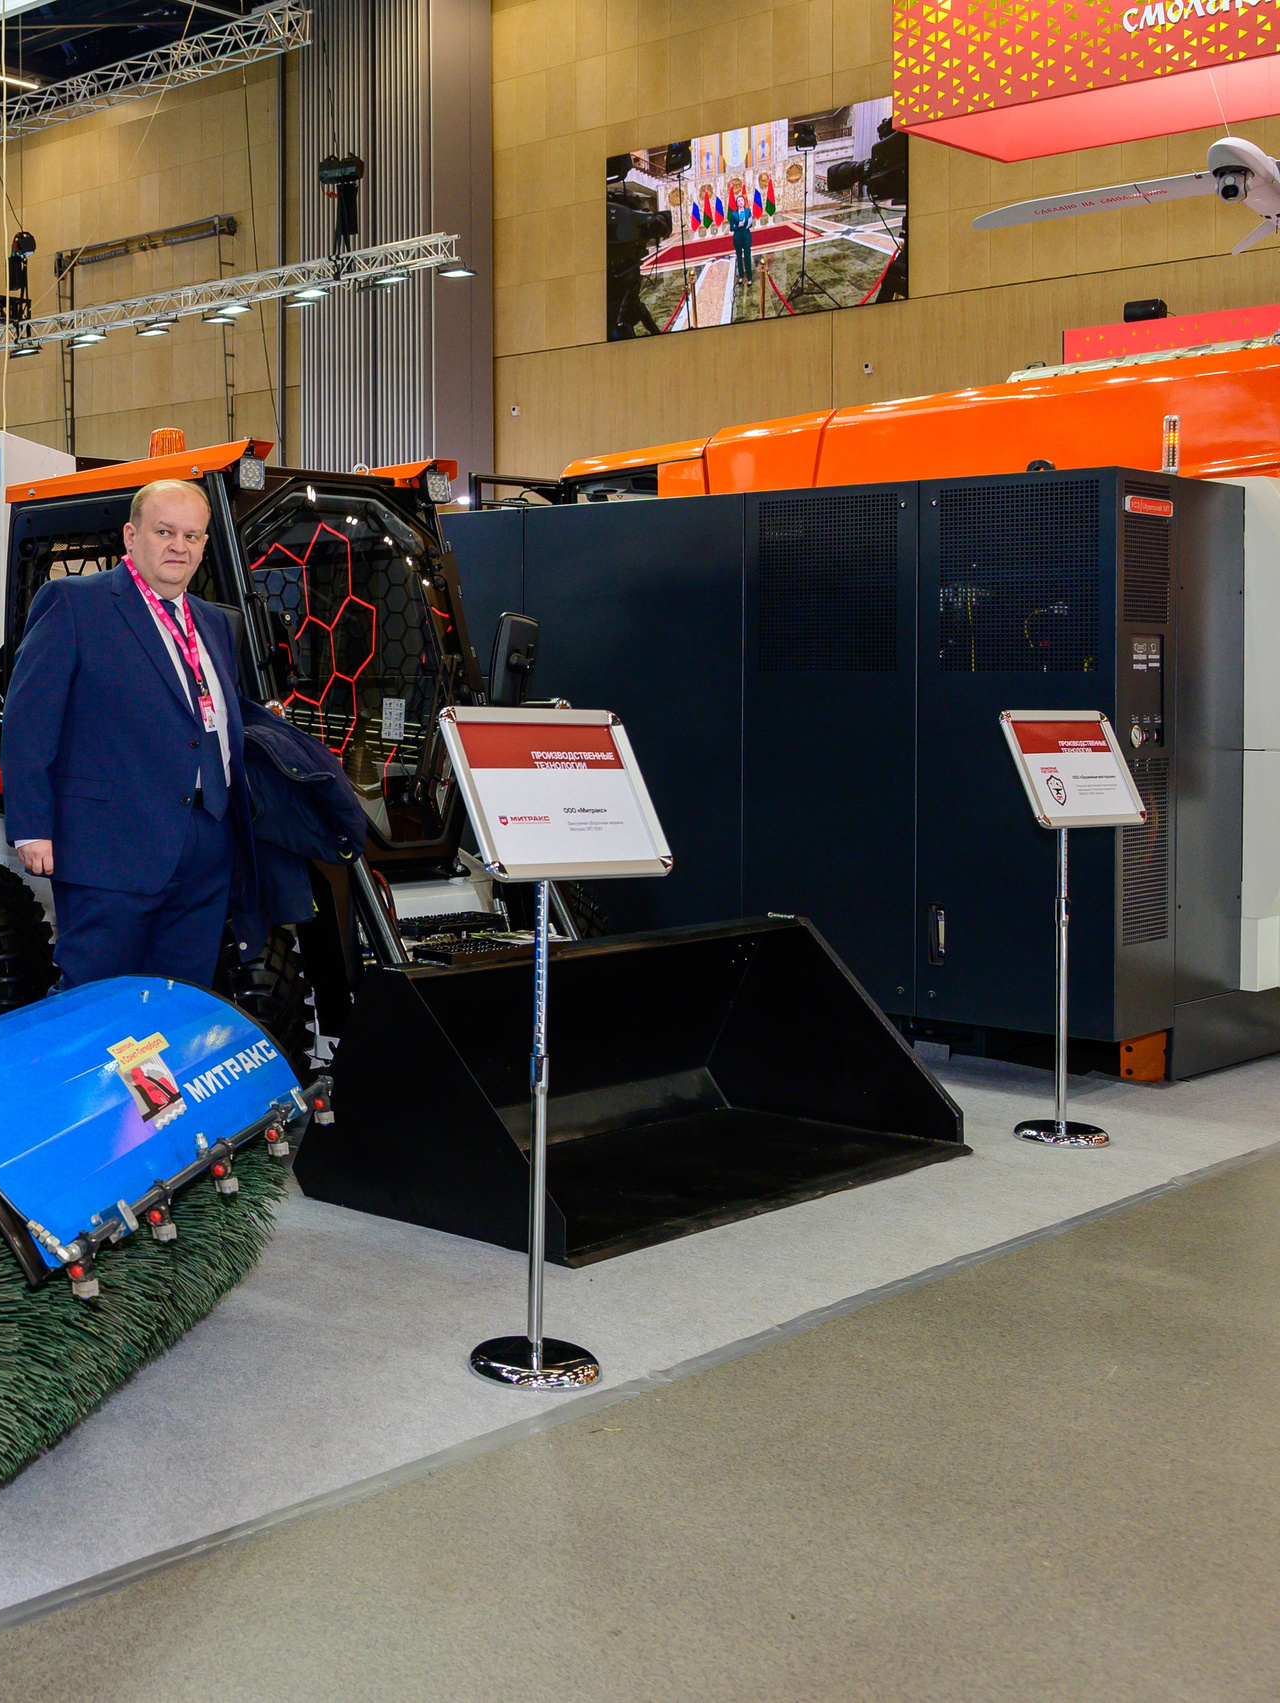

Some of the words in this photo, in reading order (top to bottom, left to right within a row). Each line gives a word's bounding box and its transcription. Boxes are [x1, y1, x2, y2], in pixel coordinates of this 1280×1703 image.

[531, 751, 616, 761] ПРОИЗВОДСТВЕННЫЕ
[534, 761, 588, 769] ТЕХНОЛОГИИ
[183, 1038, 278, 1104] МИТРАКС
